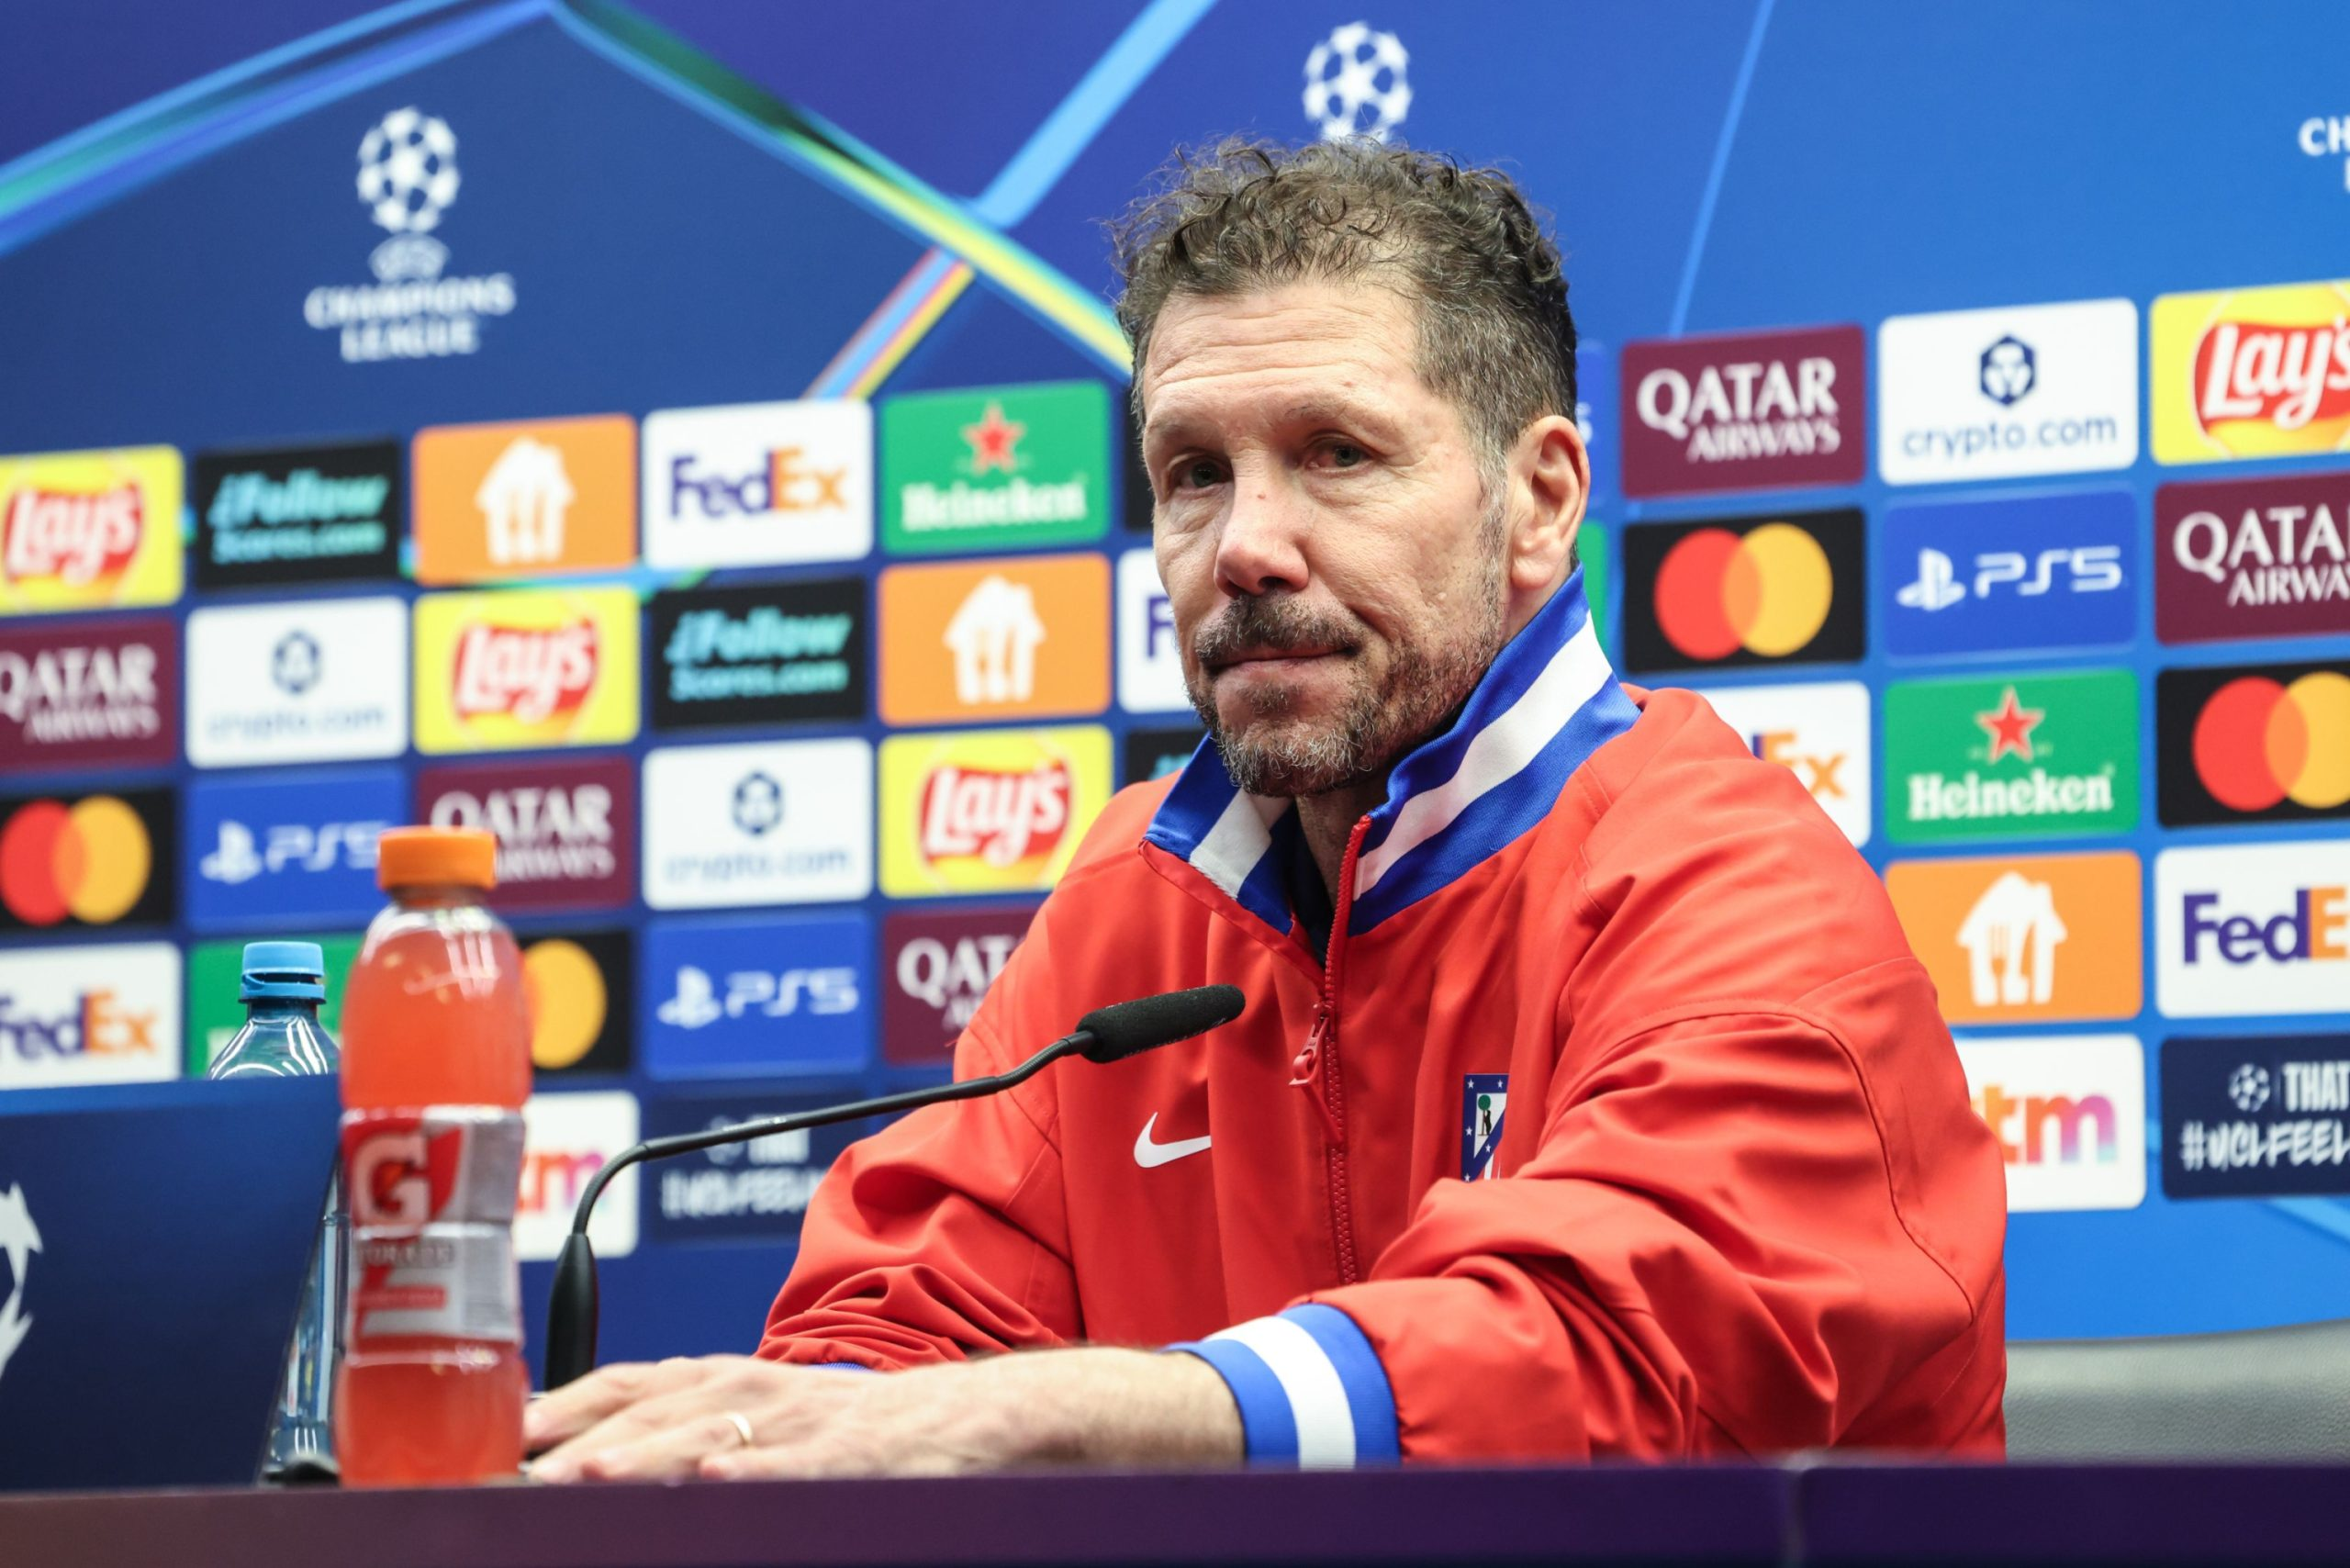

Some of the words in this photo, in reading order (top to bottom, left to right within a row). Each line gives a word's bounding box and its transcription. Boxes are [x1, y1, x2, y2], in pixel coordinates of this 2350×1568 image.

[1637, 357, 1839, 440] QATAR
[1686, 416, 1841, 464] AIRWAYS
[1903, 417, 2118, 459] crypto.com
[670, 447, 846, 519] FedEx
[901, 476, 1087, 533] Heineken
[1975, 545, 2123, 599] PS5
[2173, 503, 2350, 583] QATA
[926, 760, 1070, 868] Lay's
[1908, 767, 2114, 822] Heineken
[2183, 885, 2350, 964] FedE
[725, 967, 859, 1018] PS5
[897, 935, 1025, 1009] QAT
[352, 1133, 431, 1234] G
